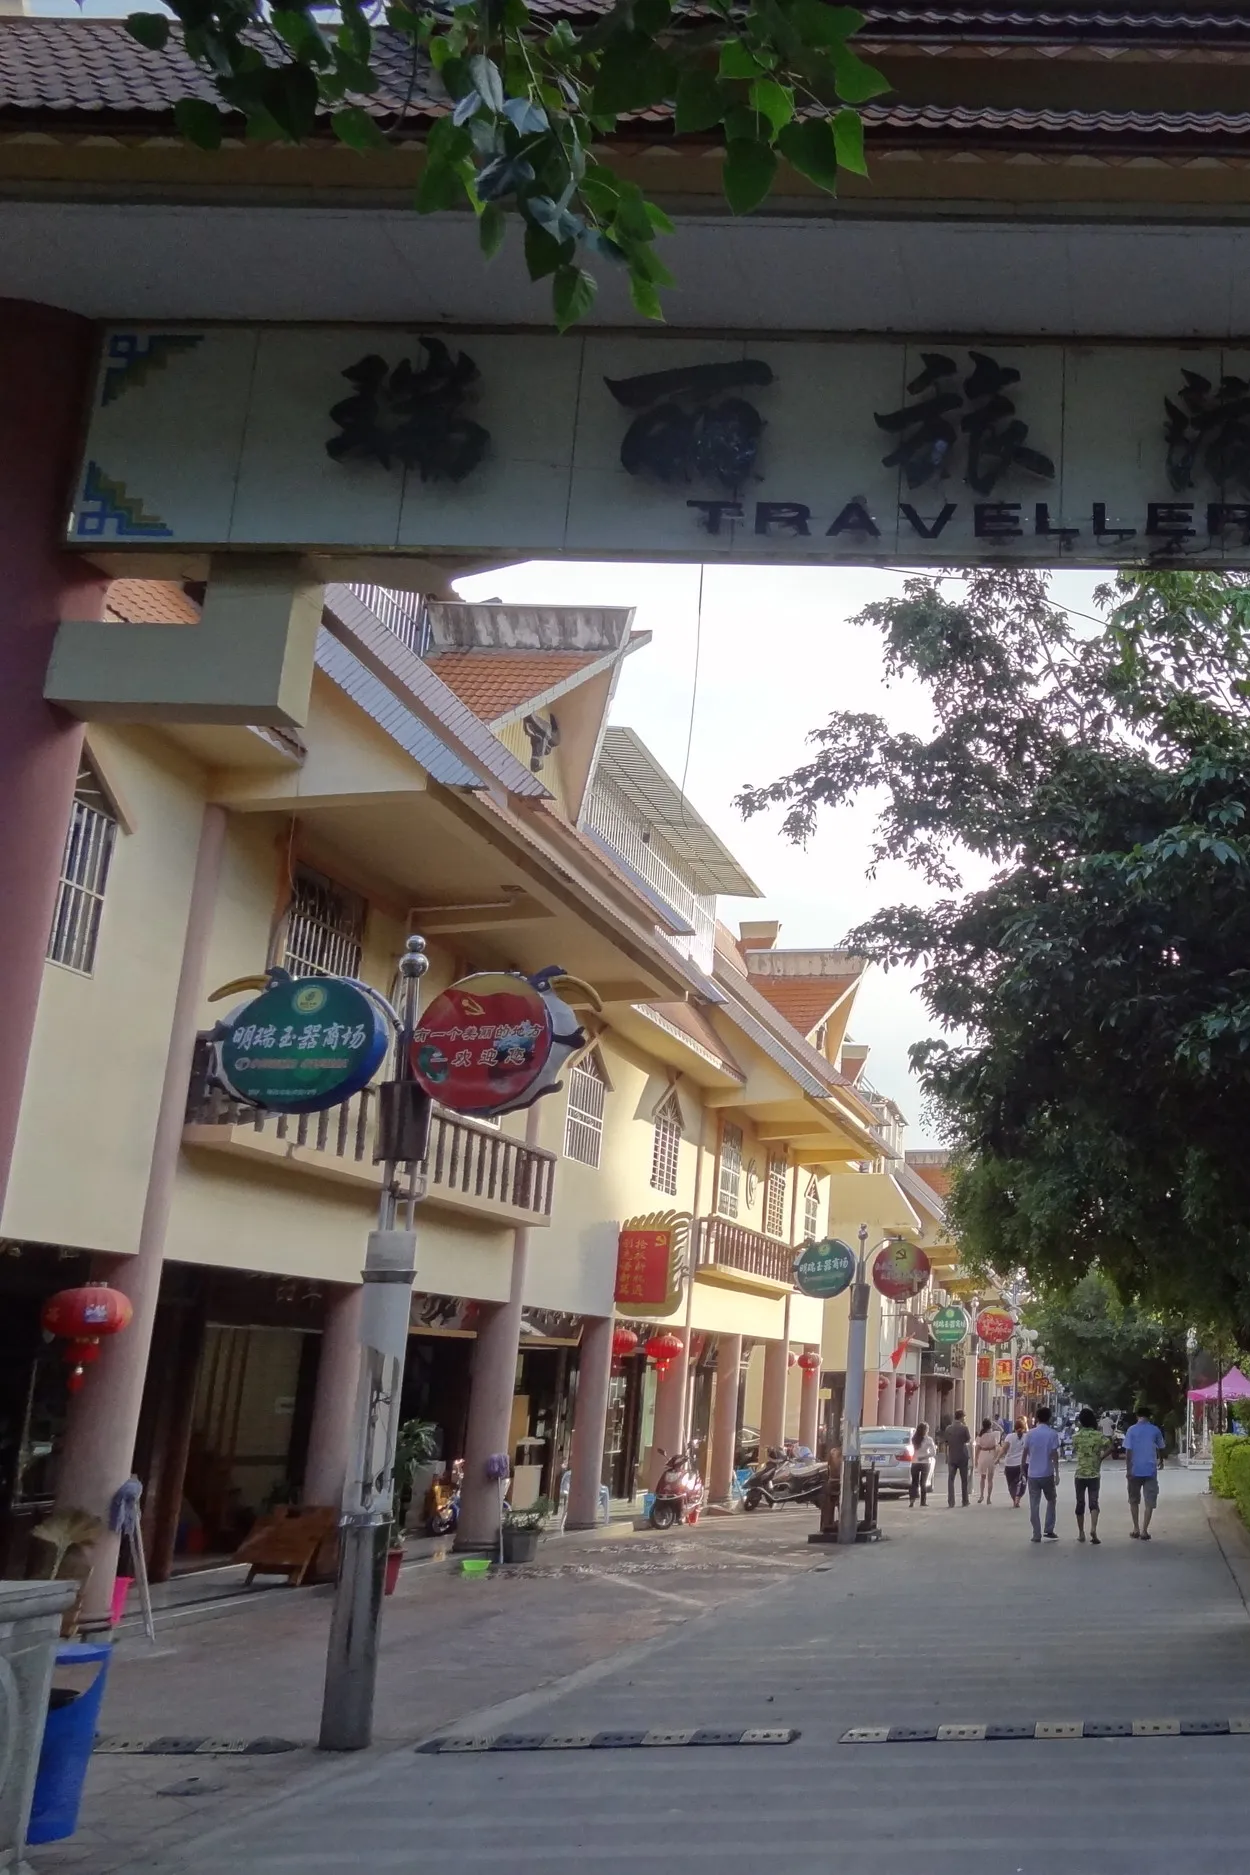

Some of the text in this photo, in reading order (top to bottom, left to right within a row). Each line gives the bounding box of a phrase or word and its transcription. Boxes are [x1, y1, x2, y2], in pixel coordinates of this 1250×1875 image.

[232, 1022, 366, 1052] 明瑞玉器商场
[413, 1023, 545, 1043] 有一个美丽的地方
